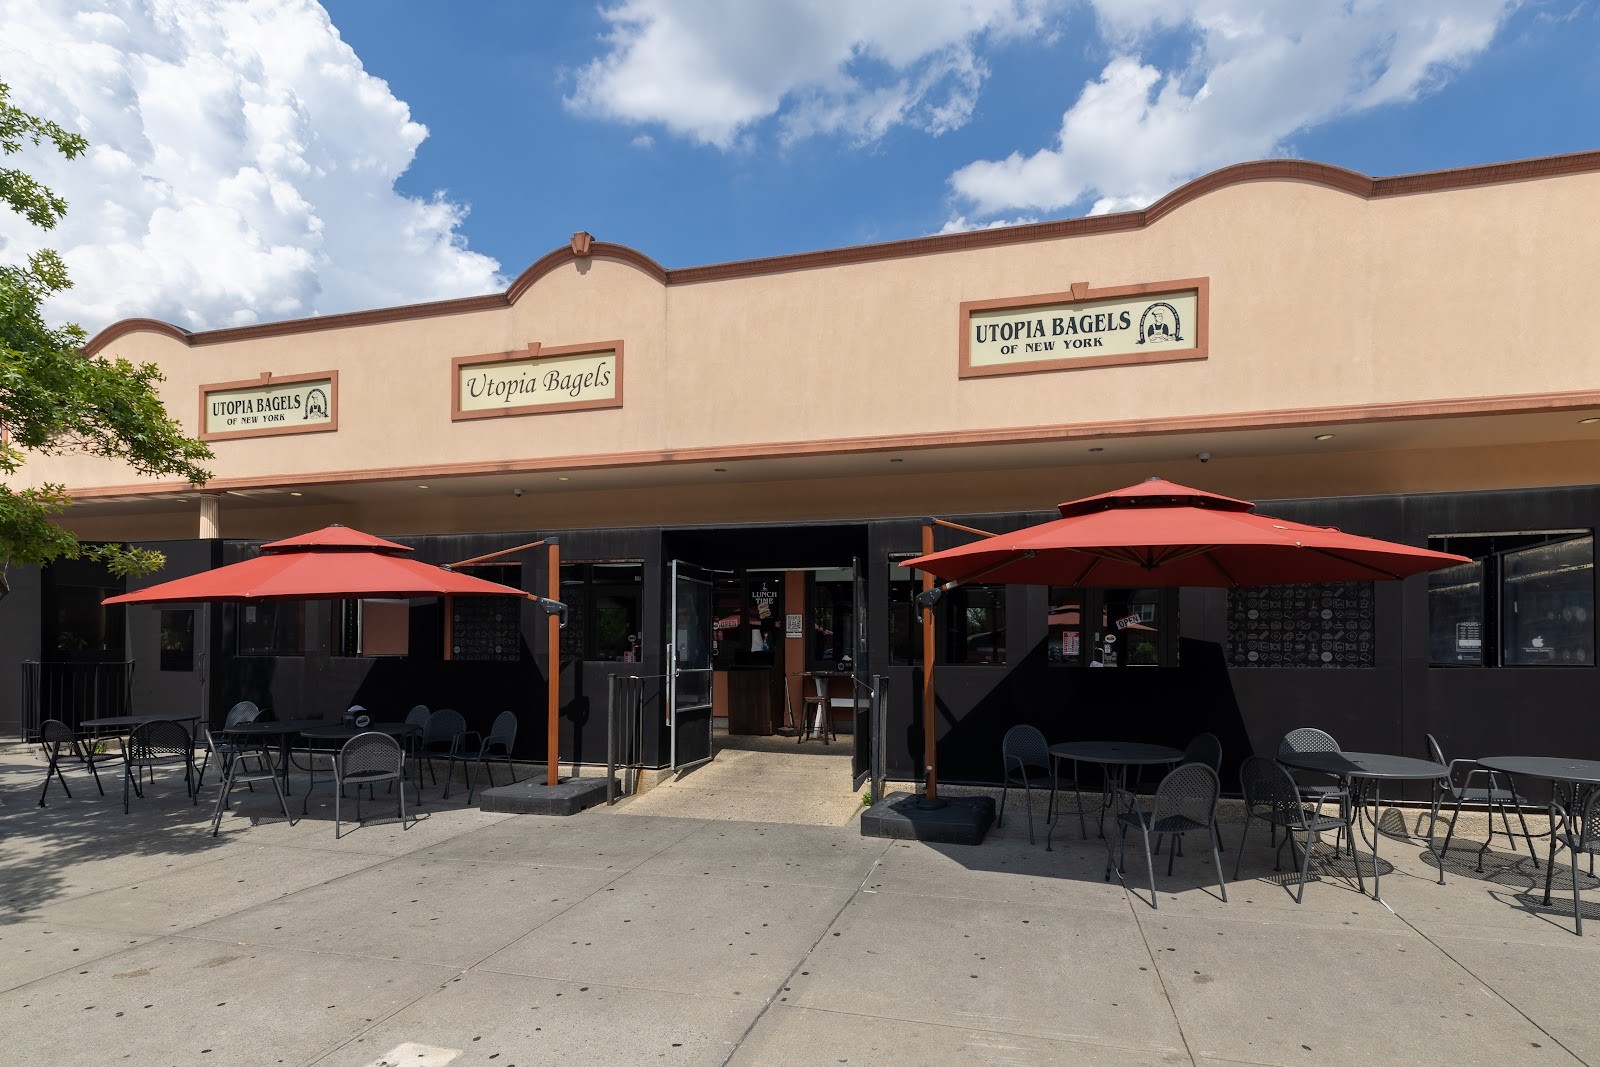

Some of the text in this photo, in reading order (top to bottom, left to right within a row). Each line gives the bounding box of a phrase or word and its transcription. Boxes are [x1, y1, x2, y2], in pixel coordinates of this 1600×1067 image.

[976, 318, 1046, 343] UTOPIA
[1052, 310, 1131, 336] BAGELS
[1000, 337, 1103, 355] OF NEW YORK
[467, 361, 611, 402] Utopia Bagels
[212, 399, 253, 416] UTOPIA
[256, 394, 300, 412] BAGELS
[226, 413, 285, 425] OF NEW YORK
[720, 620, 737, 628] OPEN
[1118, 615, 1139, 628] OPEN
